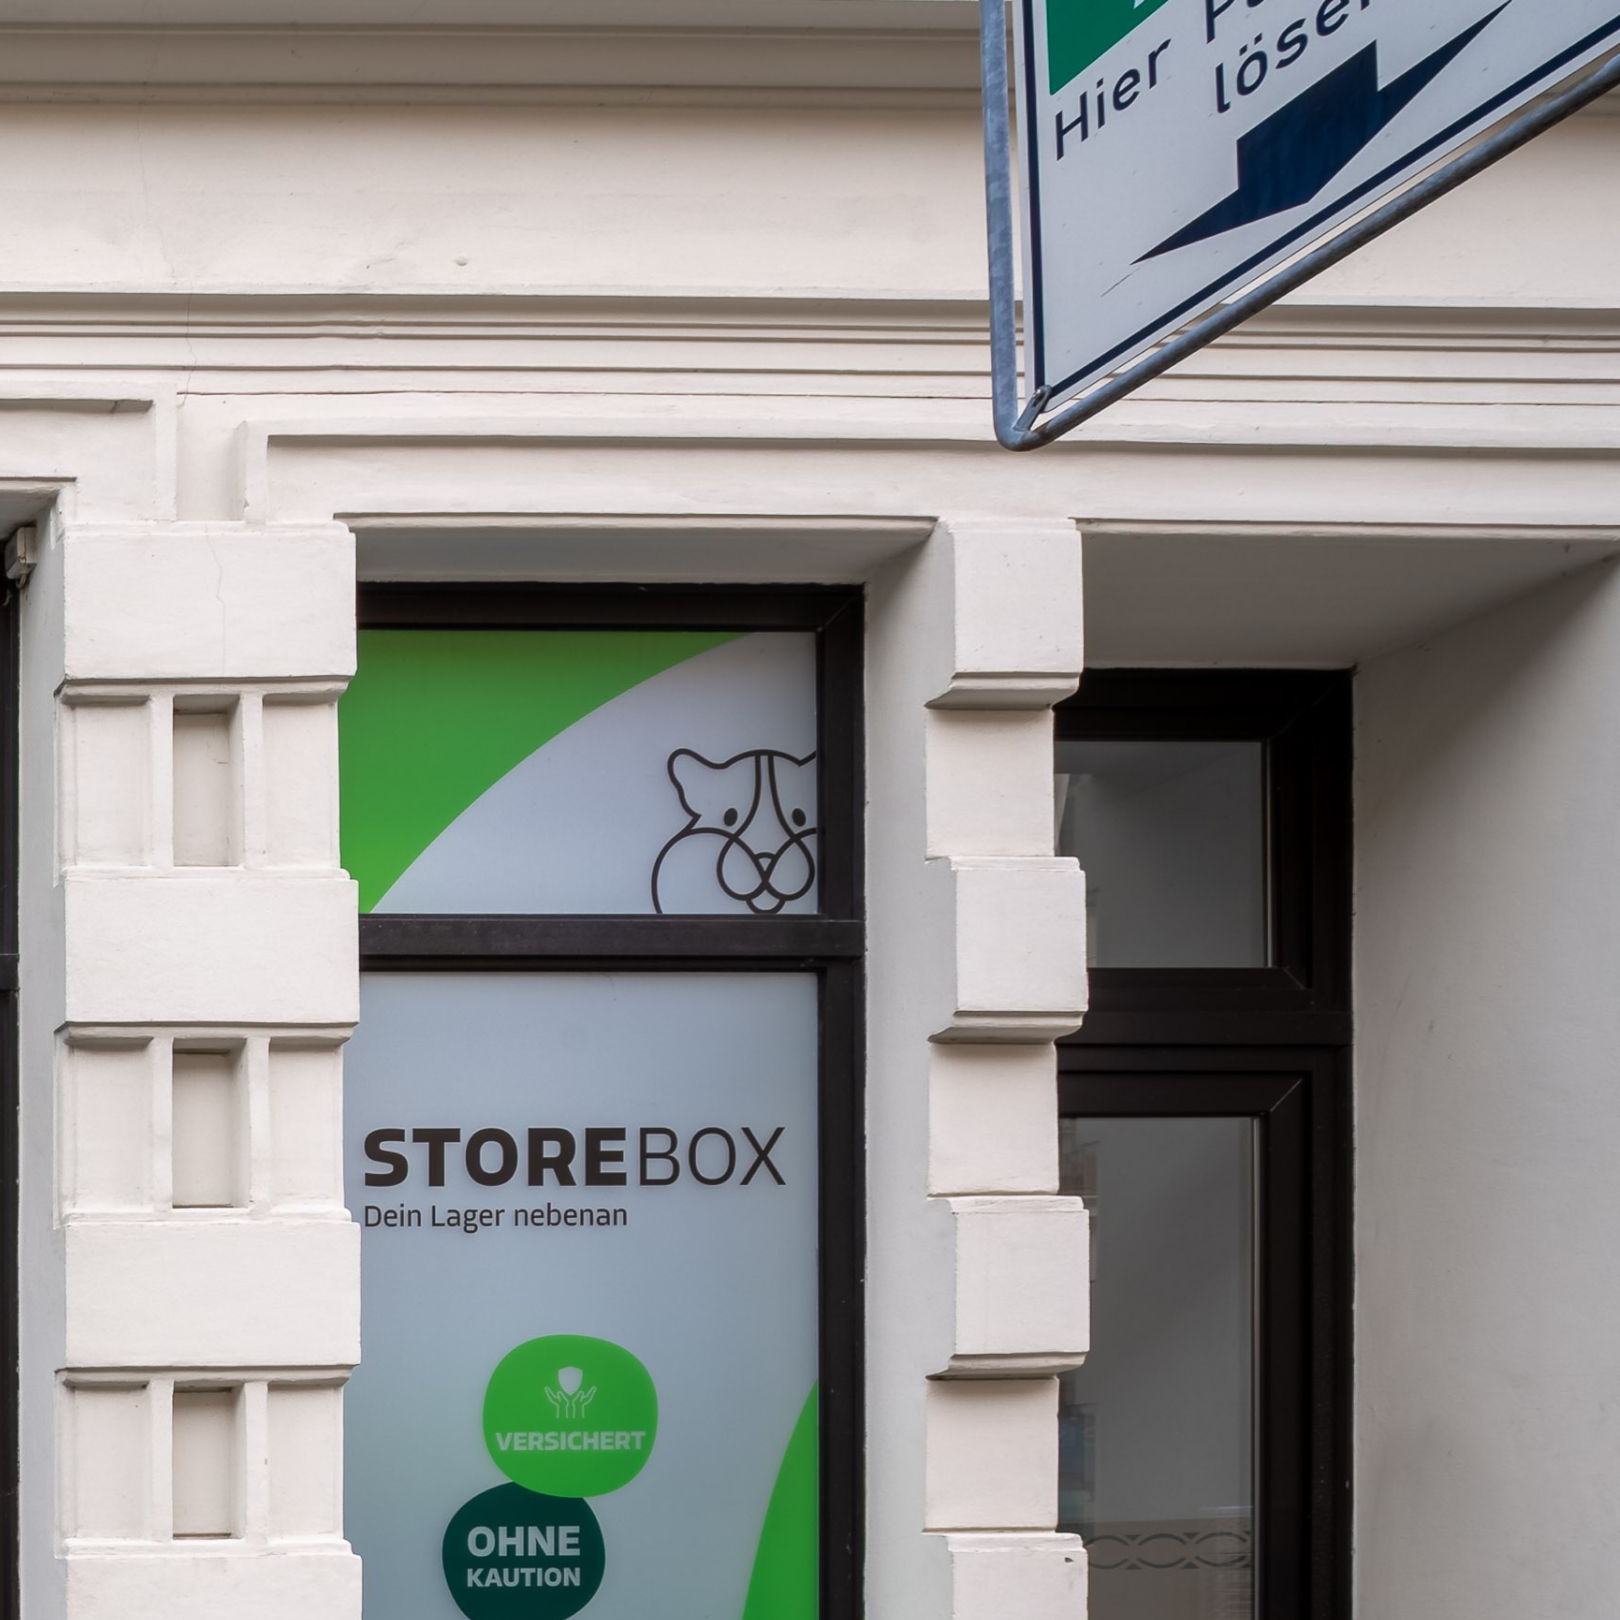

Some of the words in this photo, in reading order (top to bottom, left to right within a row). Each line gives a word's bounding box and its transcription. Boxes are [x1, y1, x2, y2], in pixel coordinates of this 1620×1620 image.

[1215, 0, 1370, 114] löse
[1056, 38, 1171, 161] Hier
[364, 1126, 786, 1187] STOREBOX
[364, 1203, 422, 1227] Dein
[431, 1205, 505, 1234] Lager
[514, 1203, 628, 1227] nebenan
[495, 1430, 646, 1451] VERSICHERT
[467, 1525, 581, 1557] OHNE
[466, 1567, 581, 1588] KAUTION
